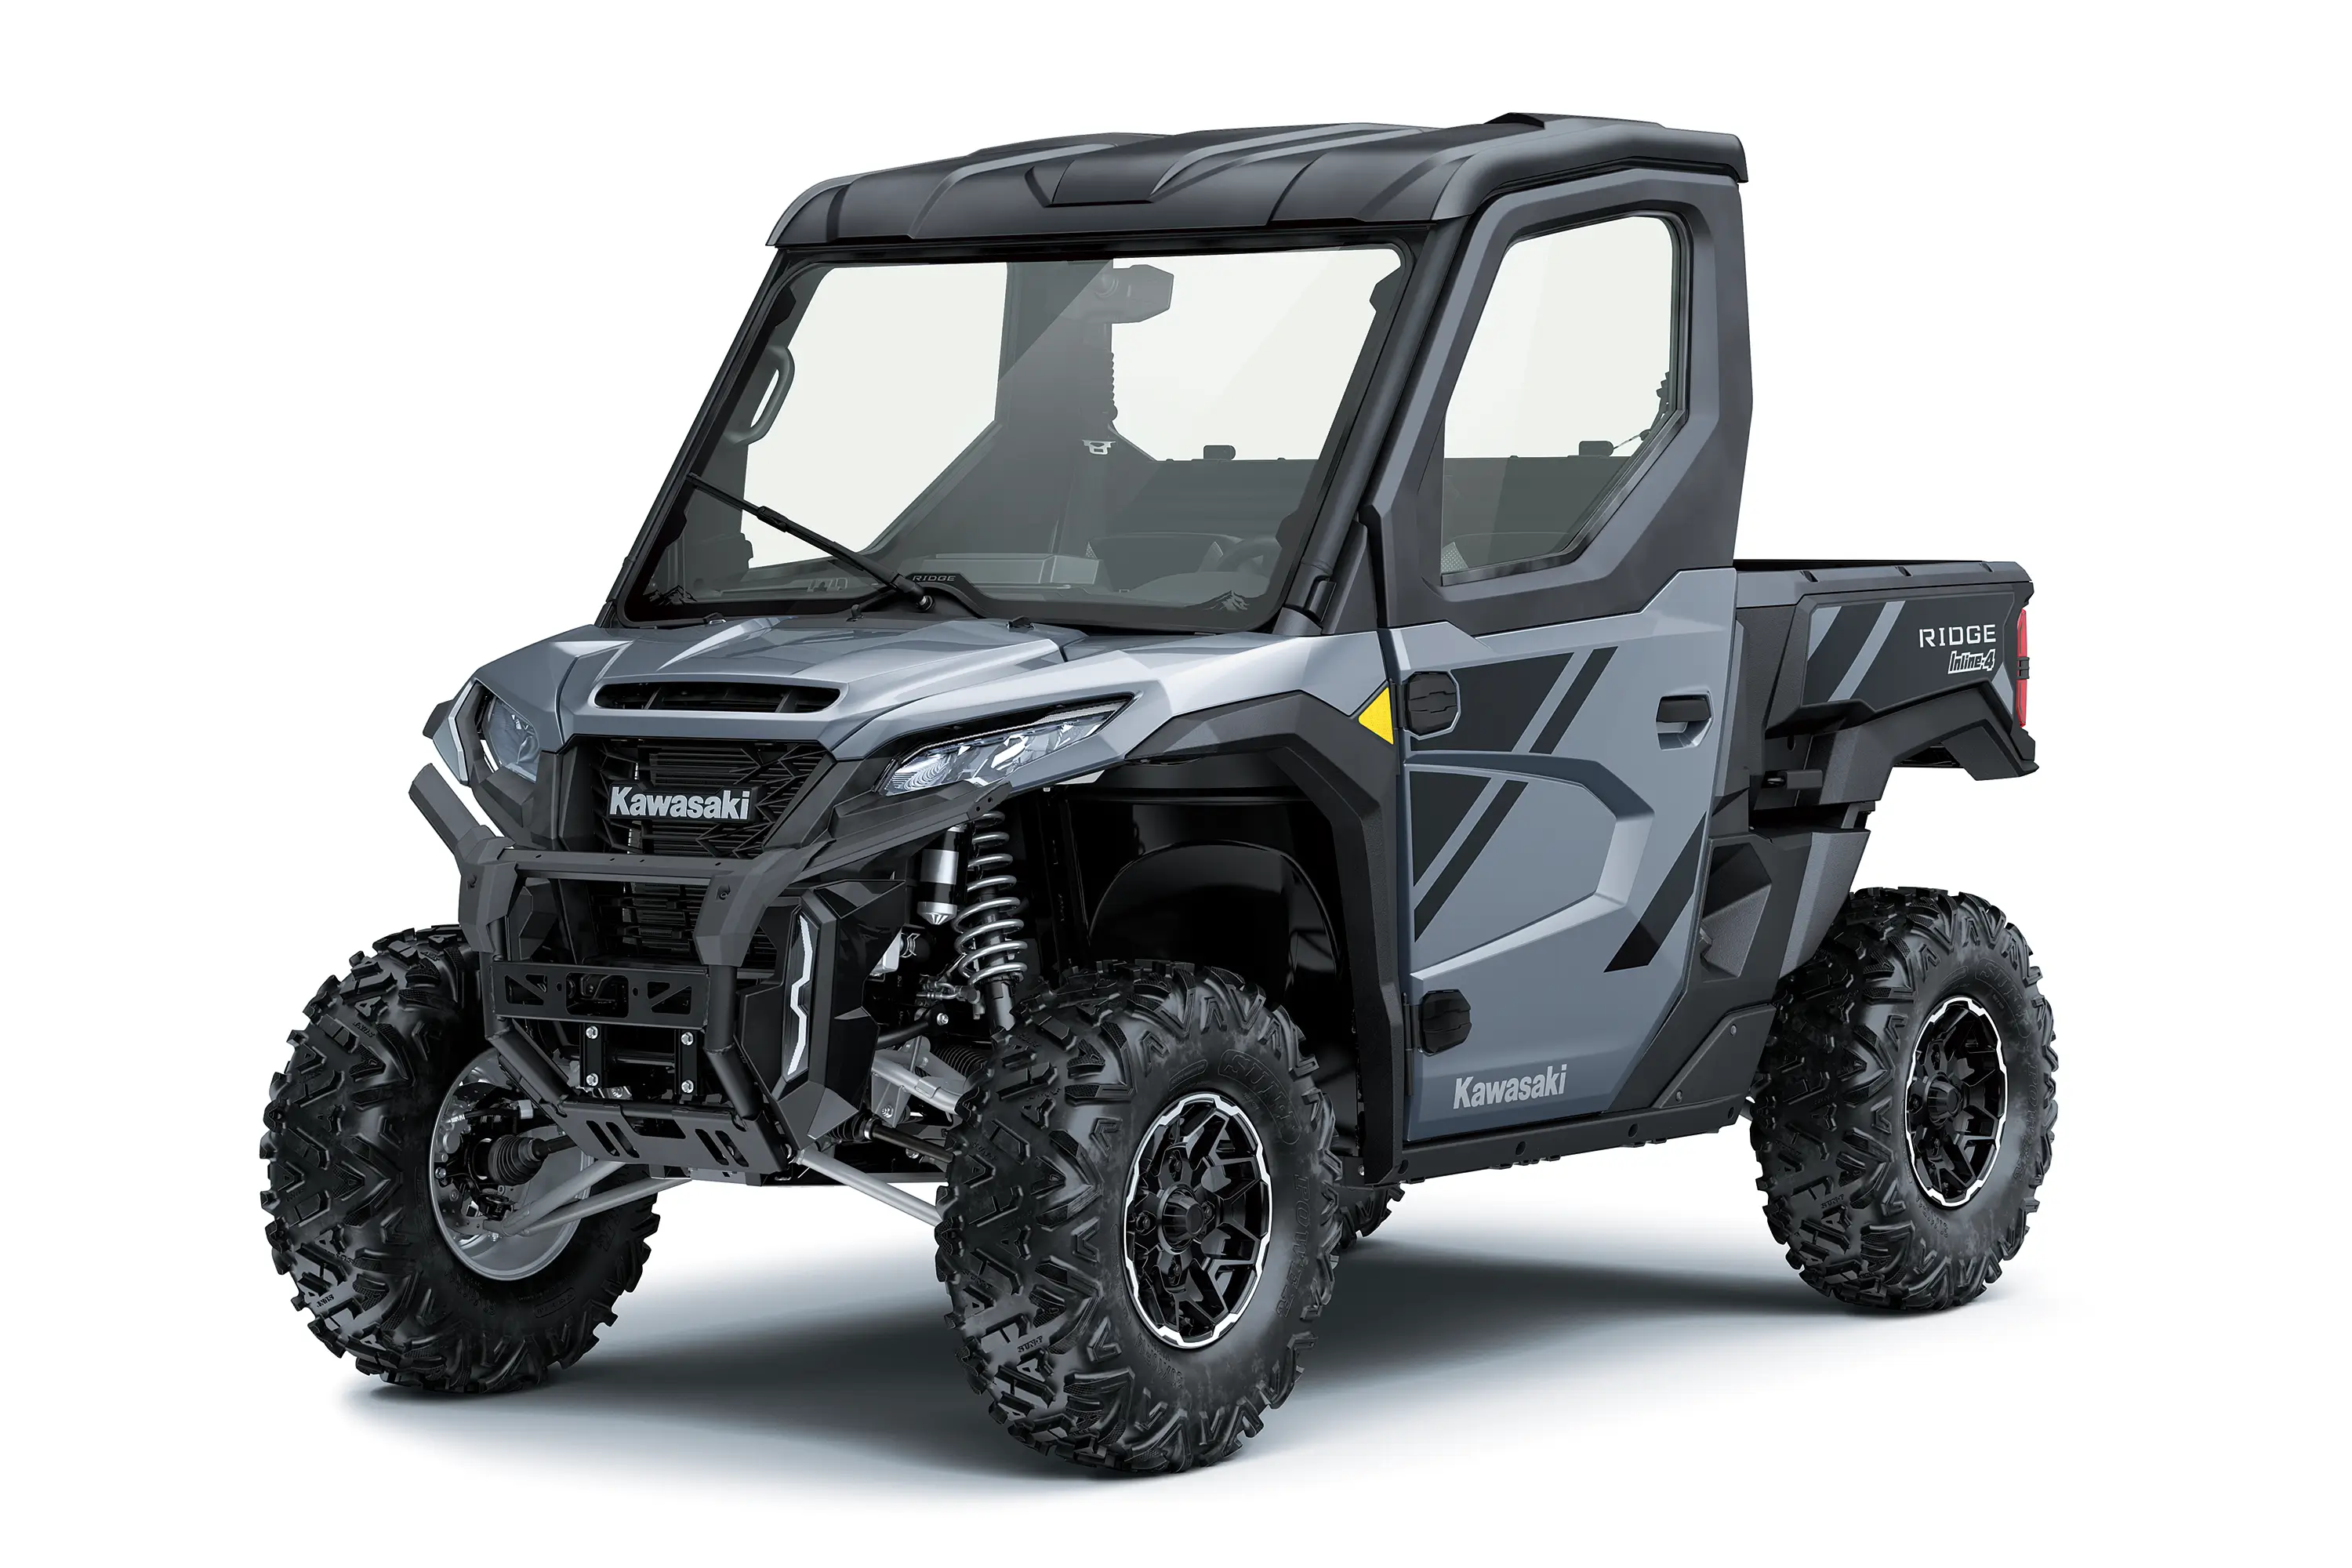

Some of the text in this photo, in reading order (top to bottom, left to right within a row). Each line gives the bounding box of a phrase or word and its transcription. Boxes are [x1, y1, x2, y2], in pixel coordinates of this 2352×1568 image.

[1918, 624, 1996, 648] RIDGE
[1947, 649, 1996, 674] Inline-4
[609, 786, 752, 820] Kawasaki
[1453, 1063, 1568, 1110] Kawasaki
[1276, 1173, 1312, 1319] POWER
